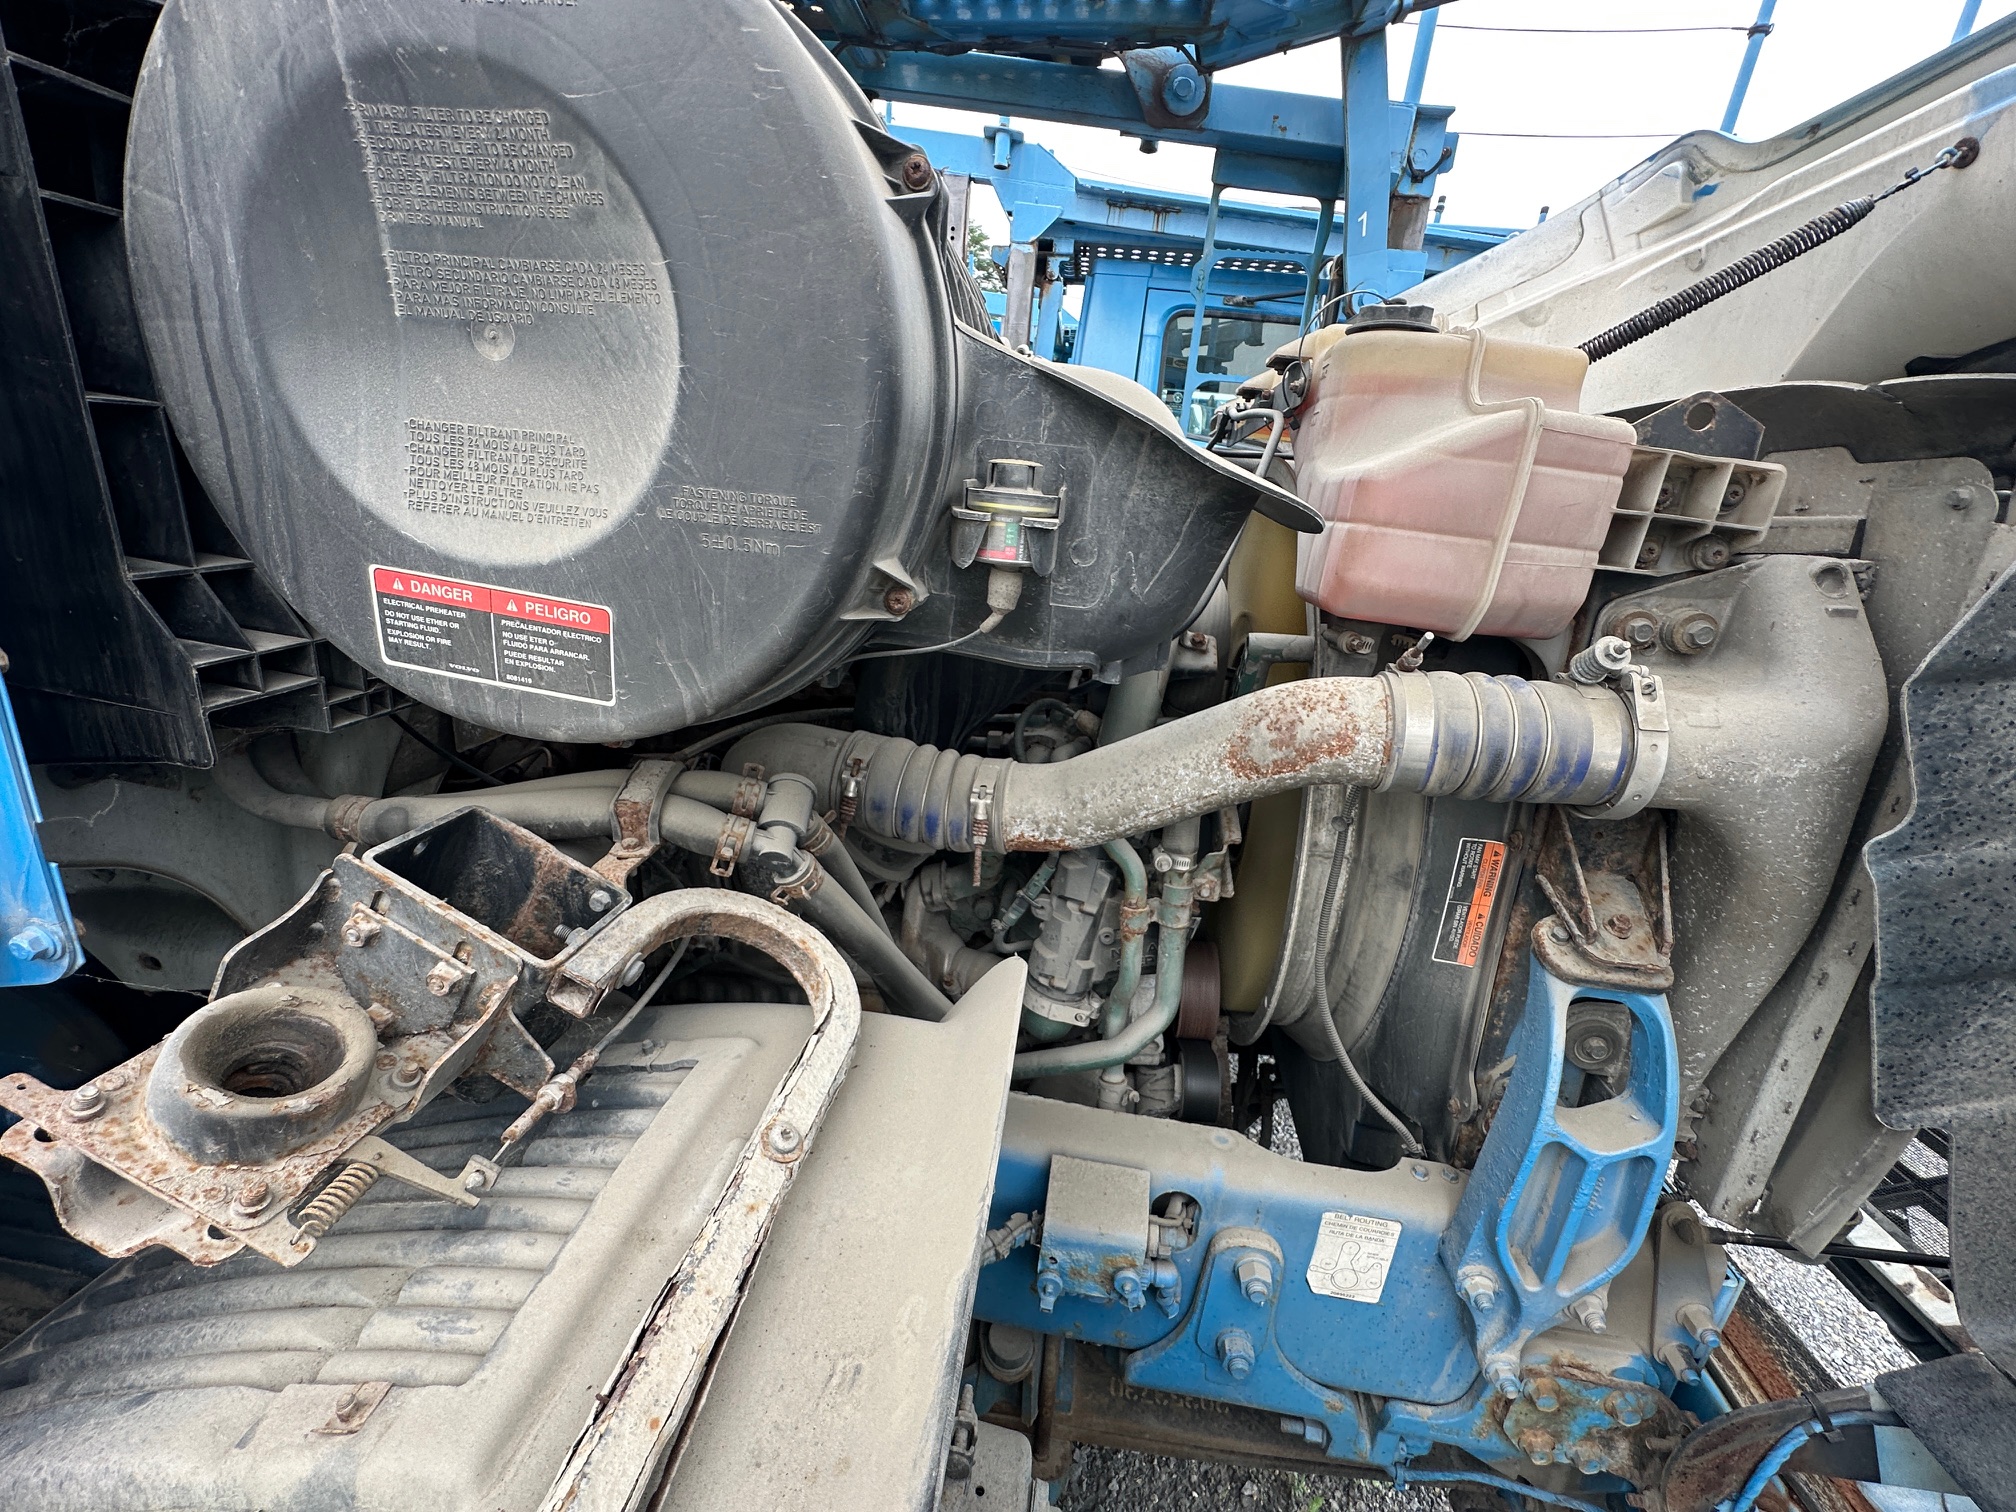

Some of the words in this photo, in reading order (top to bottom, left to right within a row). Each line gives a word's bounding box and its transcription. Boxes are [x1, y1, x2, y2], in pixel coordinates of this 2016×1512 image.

[412, 106, 455, 122] FILTER
[458, 109, 475, 123] TO
[476, 110, 492, 124] BE
[494, 110, 550, 126] CHANGED
[356, 119, 372, 131] AT
[373, 120, 401, 135] THE
[402, 121, 450, 138] LATEST
[450, 124, 490, 140] EVERY
[509, 127, 551, 142] MONTH
[439, 139, 483, 155] FILTER
[484, 141, 499, 156] TO
[501, 142, 519, 158] BE
[519, 142, 575, 159] CHANGED
[365, 150, 380, 163] AT
[383, 150, 409, 167] THE
[411, 153, 457, 170] LATEST
[459, 155, 499, 172] EVERY
[517, 159, 558, 175] MONTH
[396, 167, 430, 183] BEST
[433, 169, 504, 187] FILTRATION
[505, 173, 521, 188] DO
[523, 174, 546, 189] NOT
[549, 175, 587, 190] CLEAN
[370, 180, 415, 196] FILTER
[416, 183, 476, 201] ELEMENTS
[478, 187, 531, 203] BETWEEN
[532, 189, 555, 204] THE
[555, 191, 605, 207] CHANGES
[404, 197, 461, 213] FURTHER
[461, 200, 546, 218] INSTRUCTIONS
[549, 205, 571, 219] SEE
[435, 214, 484, 228] MANUAL
[1357, 210, 1368, 238] 1
[433, 253, 496, 270] PRINCIPAL
[498, 257, 562, 273] CAMBIARSE
[564, 260, 595, 275] CADA
[610, 262, 646, 276] MESES
[436, 267, 509, 284] SECUNDARIO
[511, 272, 575, 288] CAMBIARSE
[576, 276, 606, 289] CADA
[623, 278, 658, 291] MESES
[431, 280, 472, 295] MEJOR
[531, 288, 546, 300] NO
[548, 288, 591, 302] LIMPIAR
[593, 291, 606, 303] EL
[608, 291, 661, 305] ELEMENTO
[396, 303, 413, 317] EL
[415, 305, 466, 320] MANUAL
[468, 309, 485, 323] DE
[486, 311, 534, 326] USUARIO
[432, 293, 460, 307] MAS
[462, 296, 539, 312] INFORMACION
[540, 301, 595, 316] CONSULTE
[409, 430, 440, 444] TOUS
[443, 434, 465, 447] LES
[467, 436, 480, 448] 24
[482, 438, 510, 451] MOIS
[511, 441, 528, 453] AU
[529, 443, 556, 455] PLUS
[559, 445, 586, 458] TARD
[467, 424, 519, 440] FILTRANT
[521, 429, 575, 445] PRINCIPAL
[409, 453, 440, 468] TOUS
[443, 457, 465, 470] LES
[467, 460, 480, 472] 48
[482, 462, 510, 475] MOIS
[511, 465, 527, 476] AU
[529, 466, 556, 479] PLUS
[559, 468, 584, 481] TARD
[467, 448, 519, 464] FILTRANT
[521, 453, 535, 466] DE
[408, 476, 468, 494] NETTOYER
[471, 484, 484, 495] LE
[487, 484, 523, 499] FILTRE
[443, 469, 497, 485] MEILLEUR
[564, 481, 578, 493] NE
[580, 482, 600, 494] PAS
[441, 491, 529, 511] D'INSTRUCTIONS
[532, 501, 580, 516] VEUILLEZ
[582, 505, 609, 519] VOUS
[681, 485, 747, 504] FASTENING
[749, 492, 798, 508] TORQUE
[463, 505, 479, 517] AU
[481, 508, 524, 522] MANUEL
[526, 511, 592, 529] D'ENTRETIEN
[672, 496, 718, 514] TORQUE
[721, 502, 737, 515] DE
[739, 504, 790, 520] APRIETE
[792, 509, 809, 522] DE
[658, 507, 673, 520] LE
[676, 509, 721, 526] COUPLE
[722, 514, 738, 527] DE
[741, 516, 798, 533] SERRAGE
[799, 522, 823, 535] EST
[410, 579, 473, 603] DANGER
[382, 597, 425, 612] ELECTRICAL
[425, 605, 467, 619] PREHEATER
[384, 609, 395, 617] DO
[395, 611, 410, 620] NOT
[410, 614, 425, 623] USE
[425, 616, 448, 628] ETHER
[448, 621, 460, 630] OR
[525, 601, 591, 625] PELIGRO
[385, 617, 419, 630] STARTING
[419, 623, 442, 634] FLUID.
[500, 619, 562, 636] PRECALENTADOR
[562, 630, 602, 644] ELECTRICO
[386, 628, 425, 641] EXPLOSION
[425, 635, 436, 644] OR
[436, 637, 452, 647] FIRE
[387, 636, 403, 645] MAY
[403, 639, 432, 650] RESULT.
[502, 630, 514, 639] NO
[513, 632, 528, 642] USE
[529, 635, 548, 645] ETER
[502, 639, 528, 650] FLUIDO
[529, 643, 549, 653] PARA
[448, 662, 480, 673] VOLVO
[503, 649, 527, 660] PUEDE
[528, 653, 565, 667] RESULTAR
[504, 657, 515, 666] EN
[1483, 859, 1501, 897] WARNING
[1468, 921, 1484, 958] CUIDADO
[1334, 1213, 1352, 1221] BELT
[1354, 1216, 1389, 1228] ROUTING
[1364, 1235, 1385, 1243] BANDA
